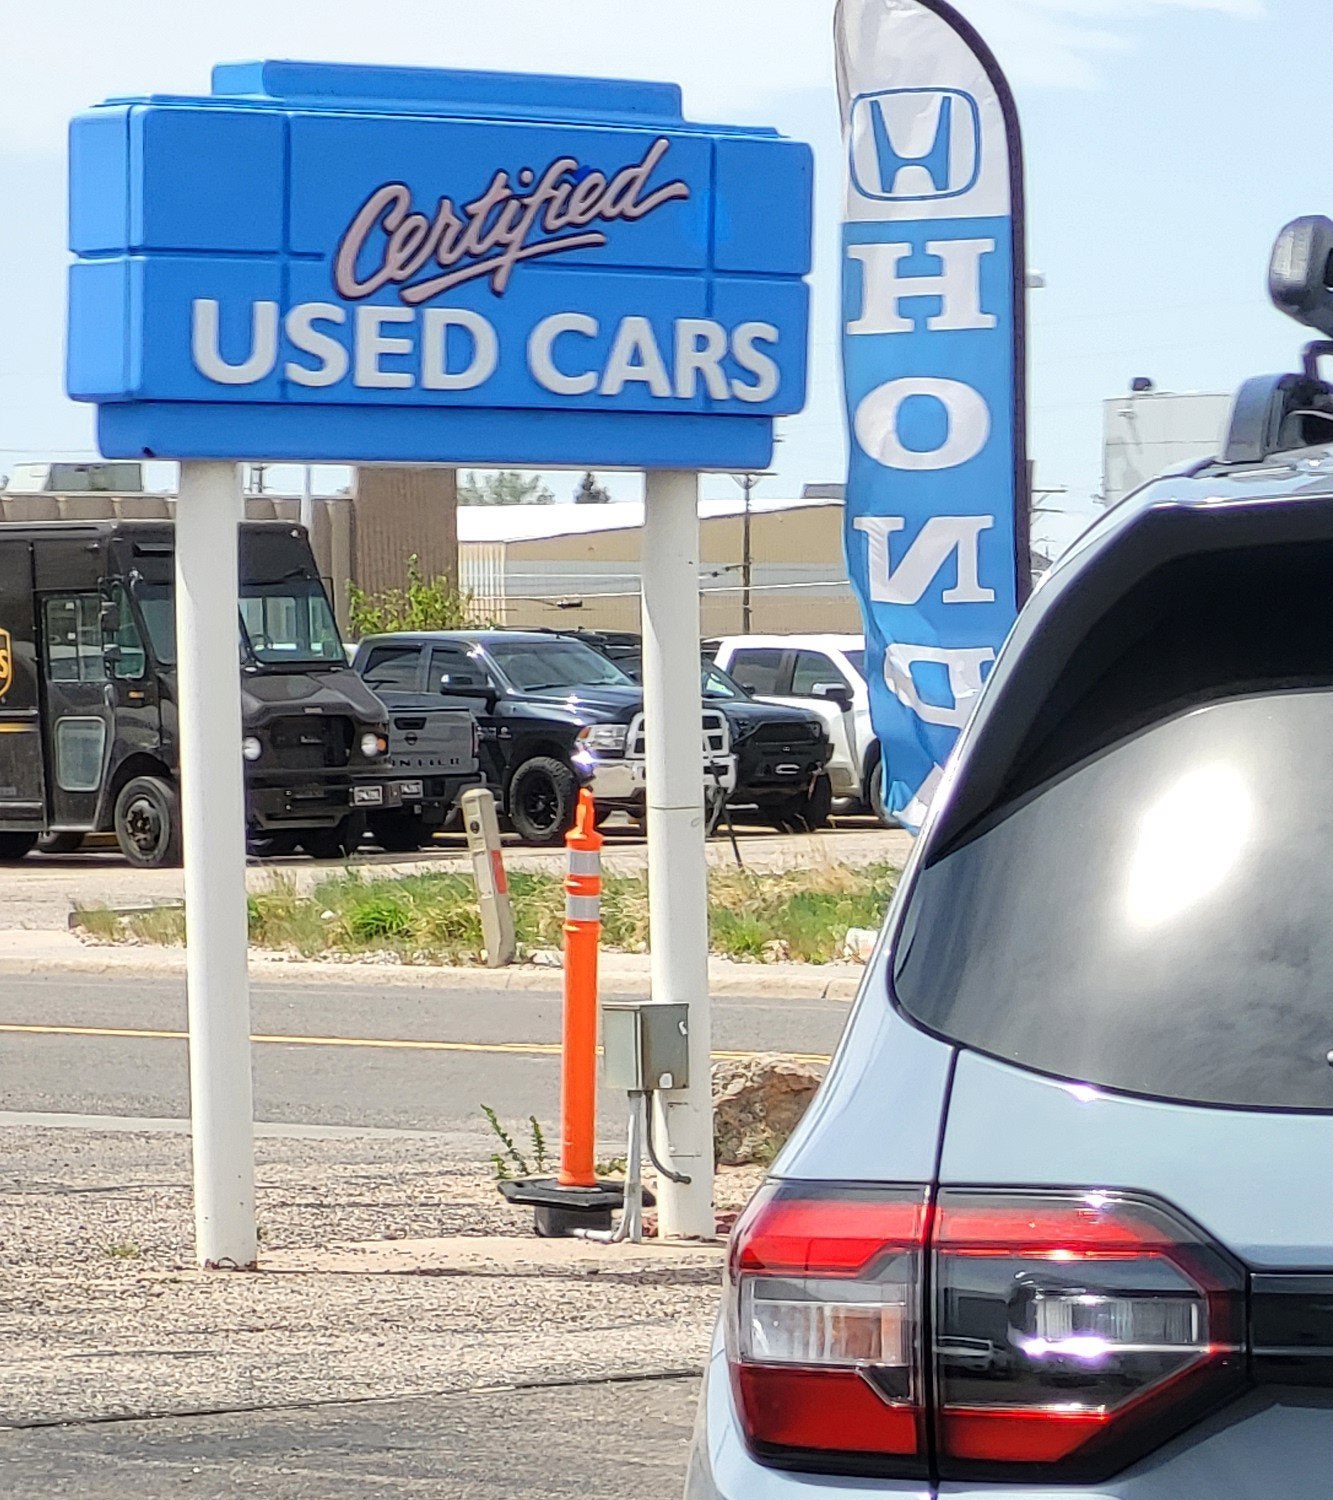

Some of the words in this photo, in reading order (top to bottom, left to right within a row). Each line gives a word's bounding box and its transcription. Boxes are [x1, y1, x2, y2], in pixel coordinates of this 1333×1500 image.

[333, 135, 690, 307] Certified
[192, 298, 499, 391] USED
[526, 311, 781, 403] CARS
